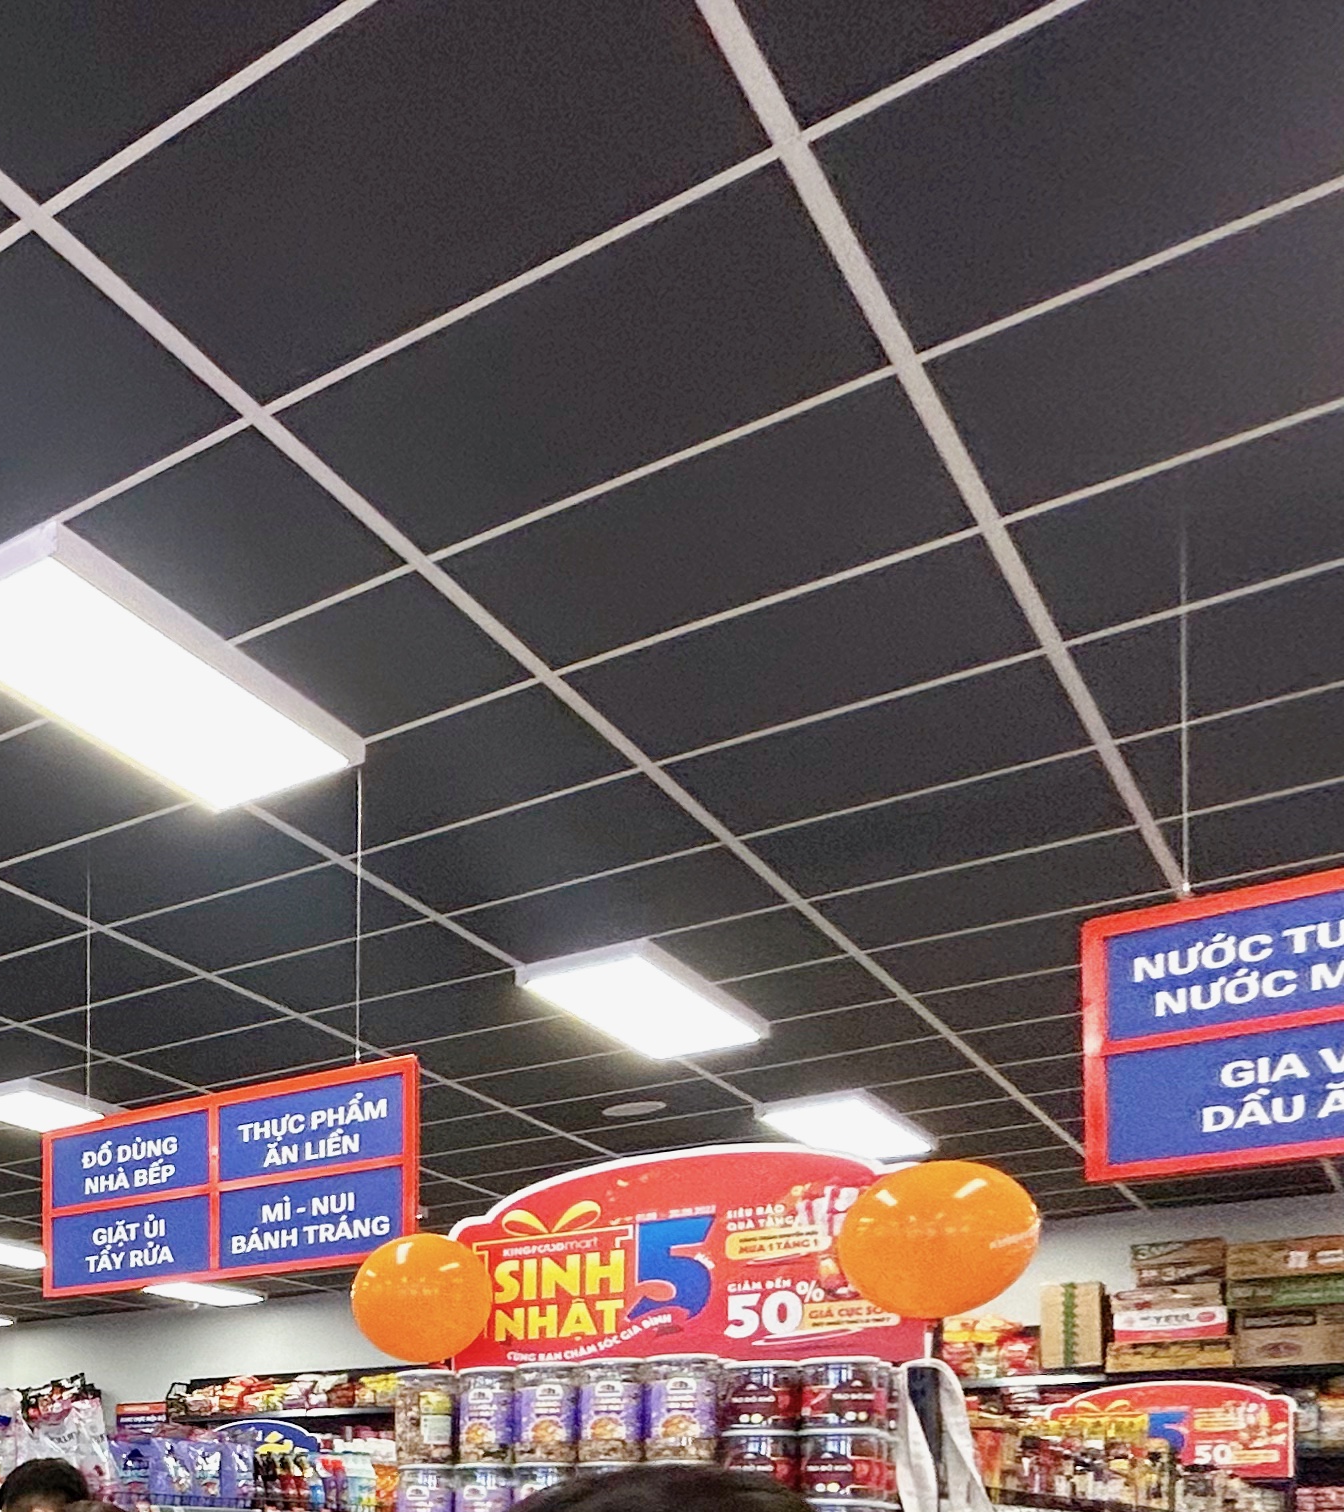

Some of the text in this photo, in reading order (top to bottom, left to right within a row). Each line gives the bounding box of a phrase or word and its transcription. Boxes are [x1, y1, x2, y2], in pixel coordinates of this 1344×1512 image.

[1132, 932, 1273, 983] NƯỚC
[1153, 967, 1298, 1016] NƯỚC
[1220, 1053, 1311, 1088] GIA
[238, 1091, 388, 1145] THỰC PHẨM
[1201, 1088, 1306, 1133] DẦU
[81, 1136, 179, 1170] ĐỒ DÙNG
[263, 1128, 361, 1169] ĂN LIỀN
[83, 1157, 177, 1196] NHÀ BẾP
[260, 1191, 356, 1224] MÌ NUI
[91, 1214, 166, 1250] GIẶT ỦI
[231, 1214, 391, 1256] BÁNH TRÁNG
[84, 1241, 174, 1274] TẨY RỬA
[493, 1214, 716, 1321] SINH 5
[494, 1297, 625, 1343] NHẬT
